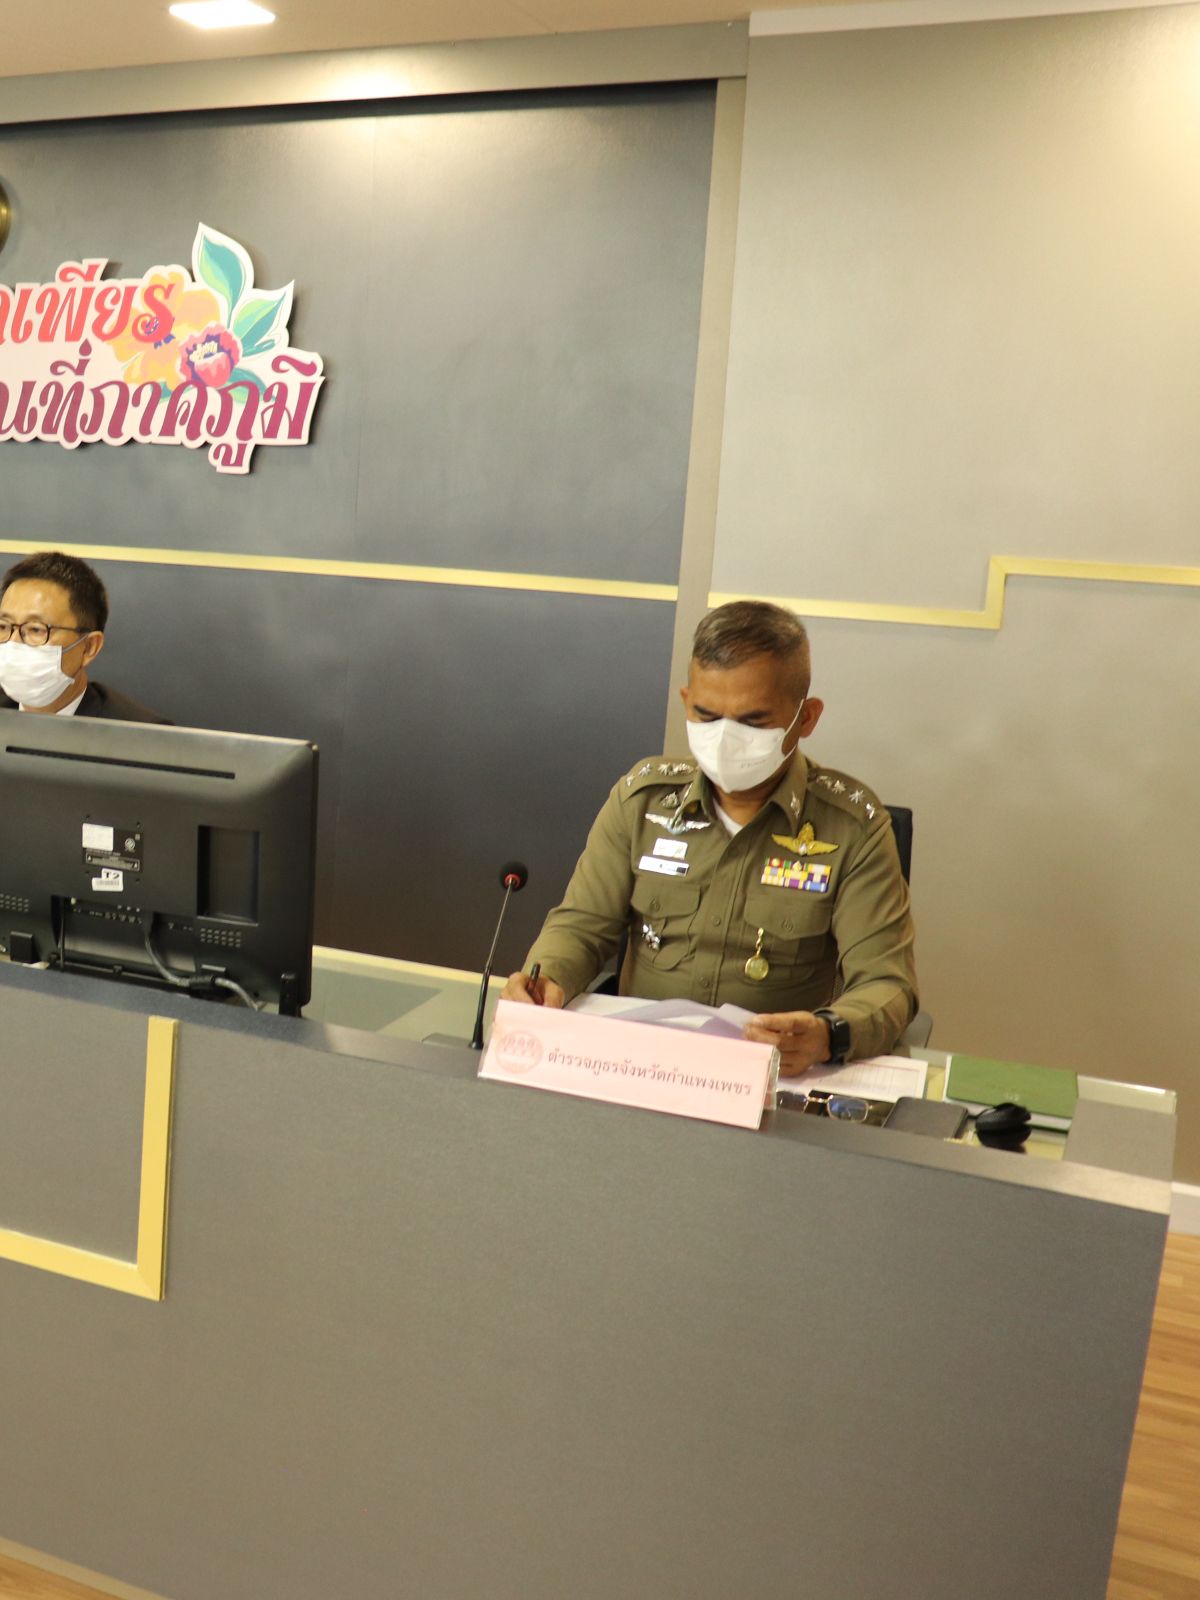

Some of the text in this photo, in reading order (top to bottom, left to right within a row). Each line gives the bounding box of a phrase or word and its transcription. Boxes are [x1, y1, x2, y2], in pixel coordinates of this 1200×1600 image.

[548, 1048, 751, 1095] ตำรวจภูธรจังหวัดกำแพงเพชร
